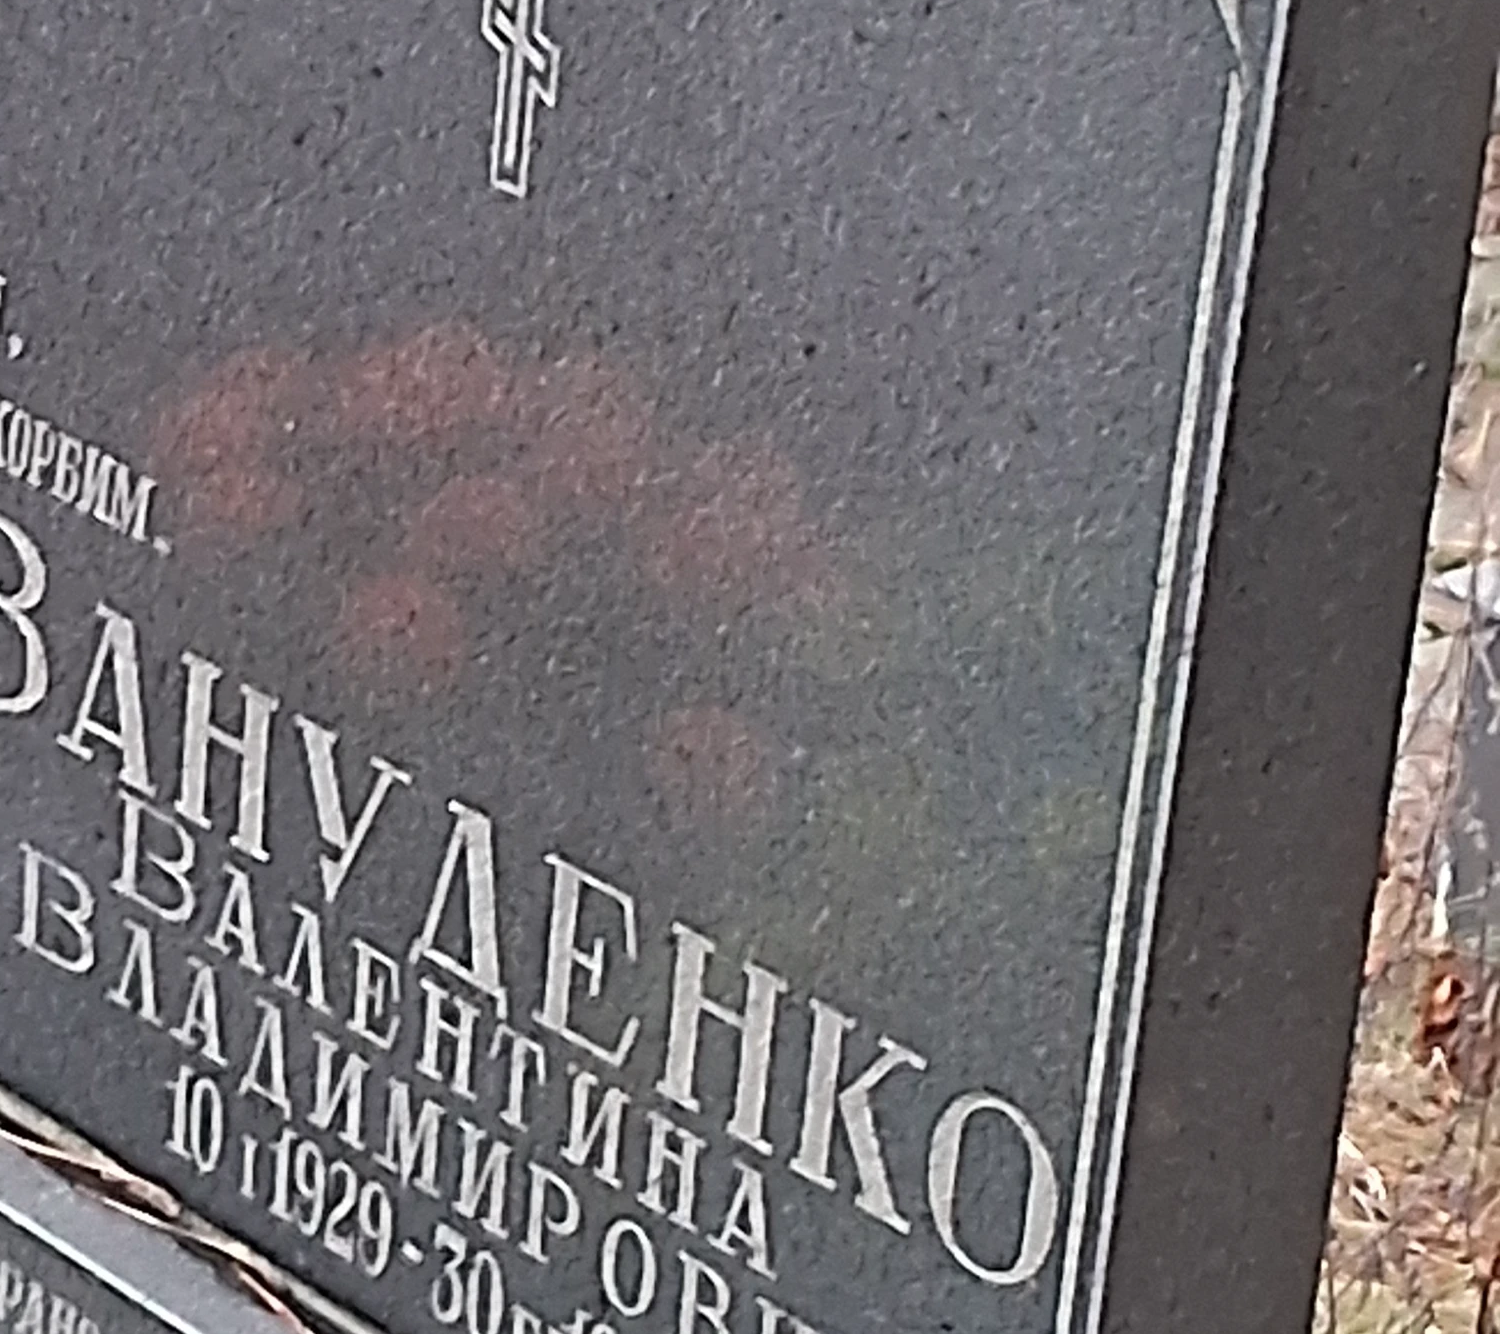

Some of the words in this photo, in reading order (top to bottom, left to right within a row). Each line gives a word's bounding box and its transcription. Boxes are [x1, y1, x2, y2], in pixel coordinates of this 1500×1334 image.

[112, 787, 778, 1281] ВАЛЕНТИНА
[165, 1064, 223, 1174] 10
[267, 1126, 395, 1279] 1929
